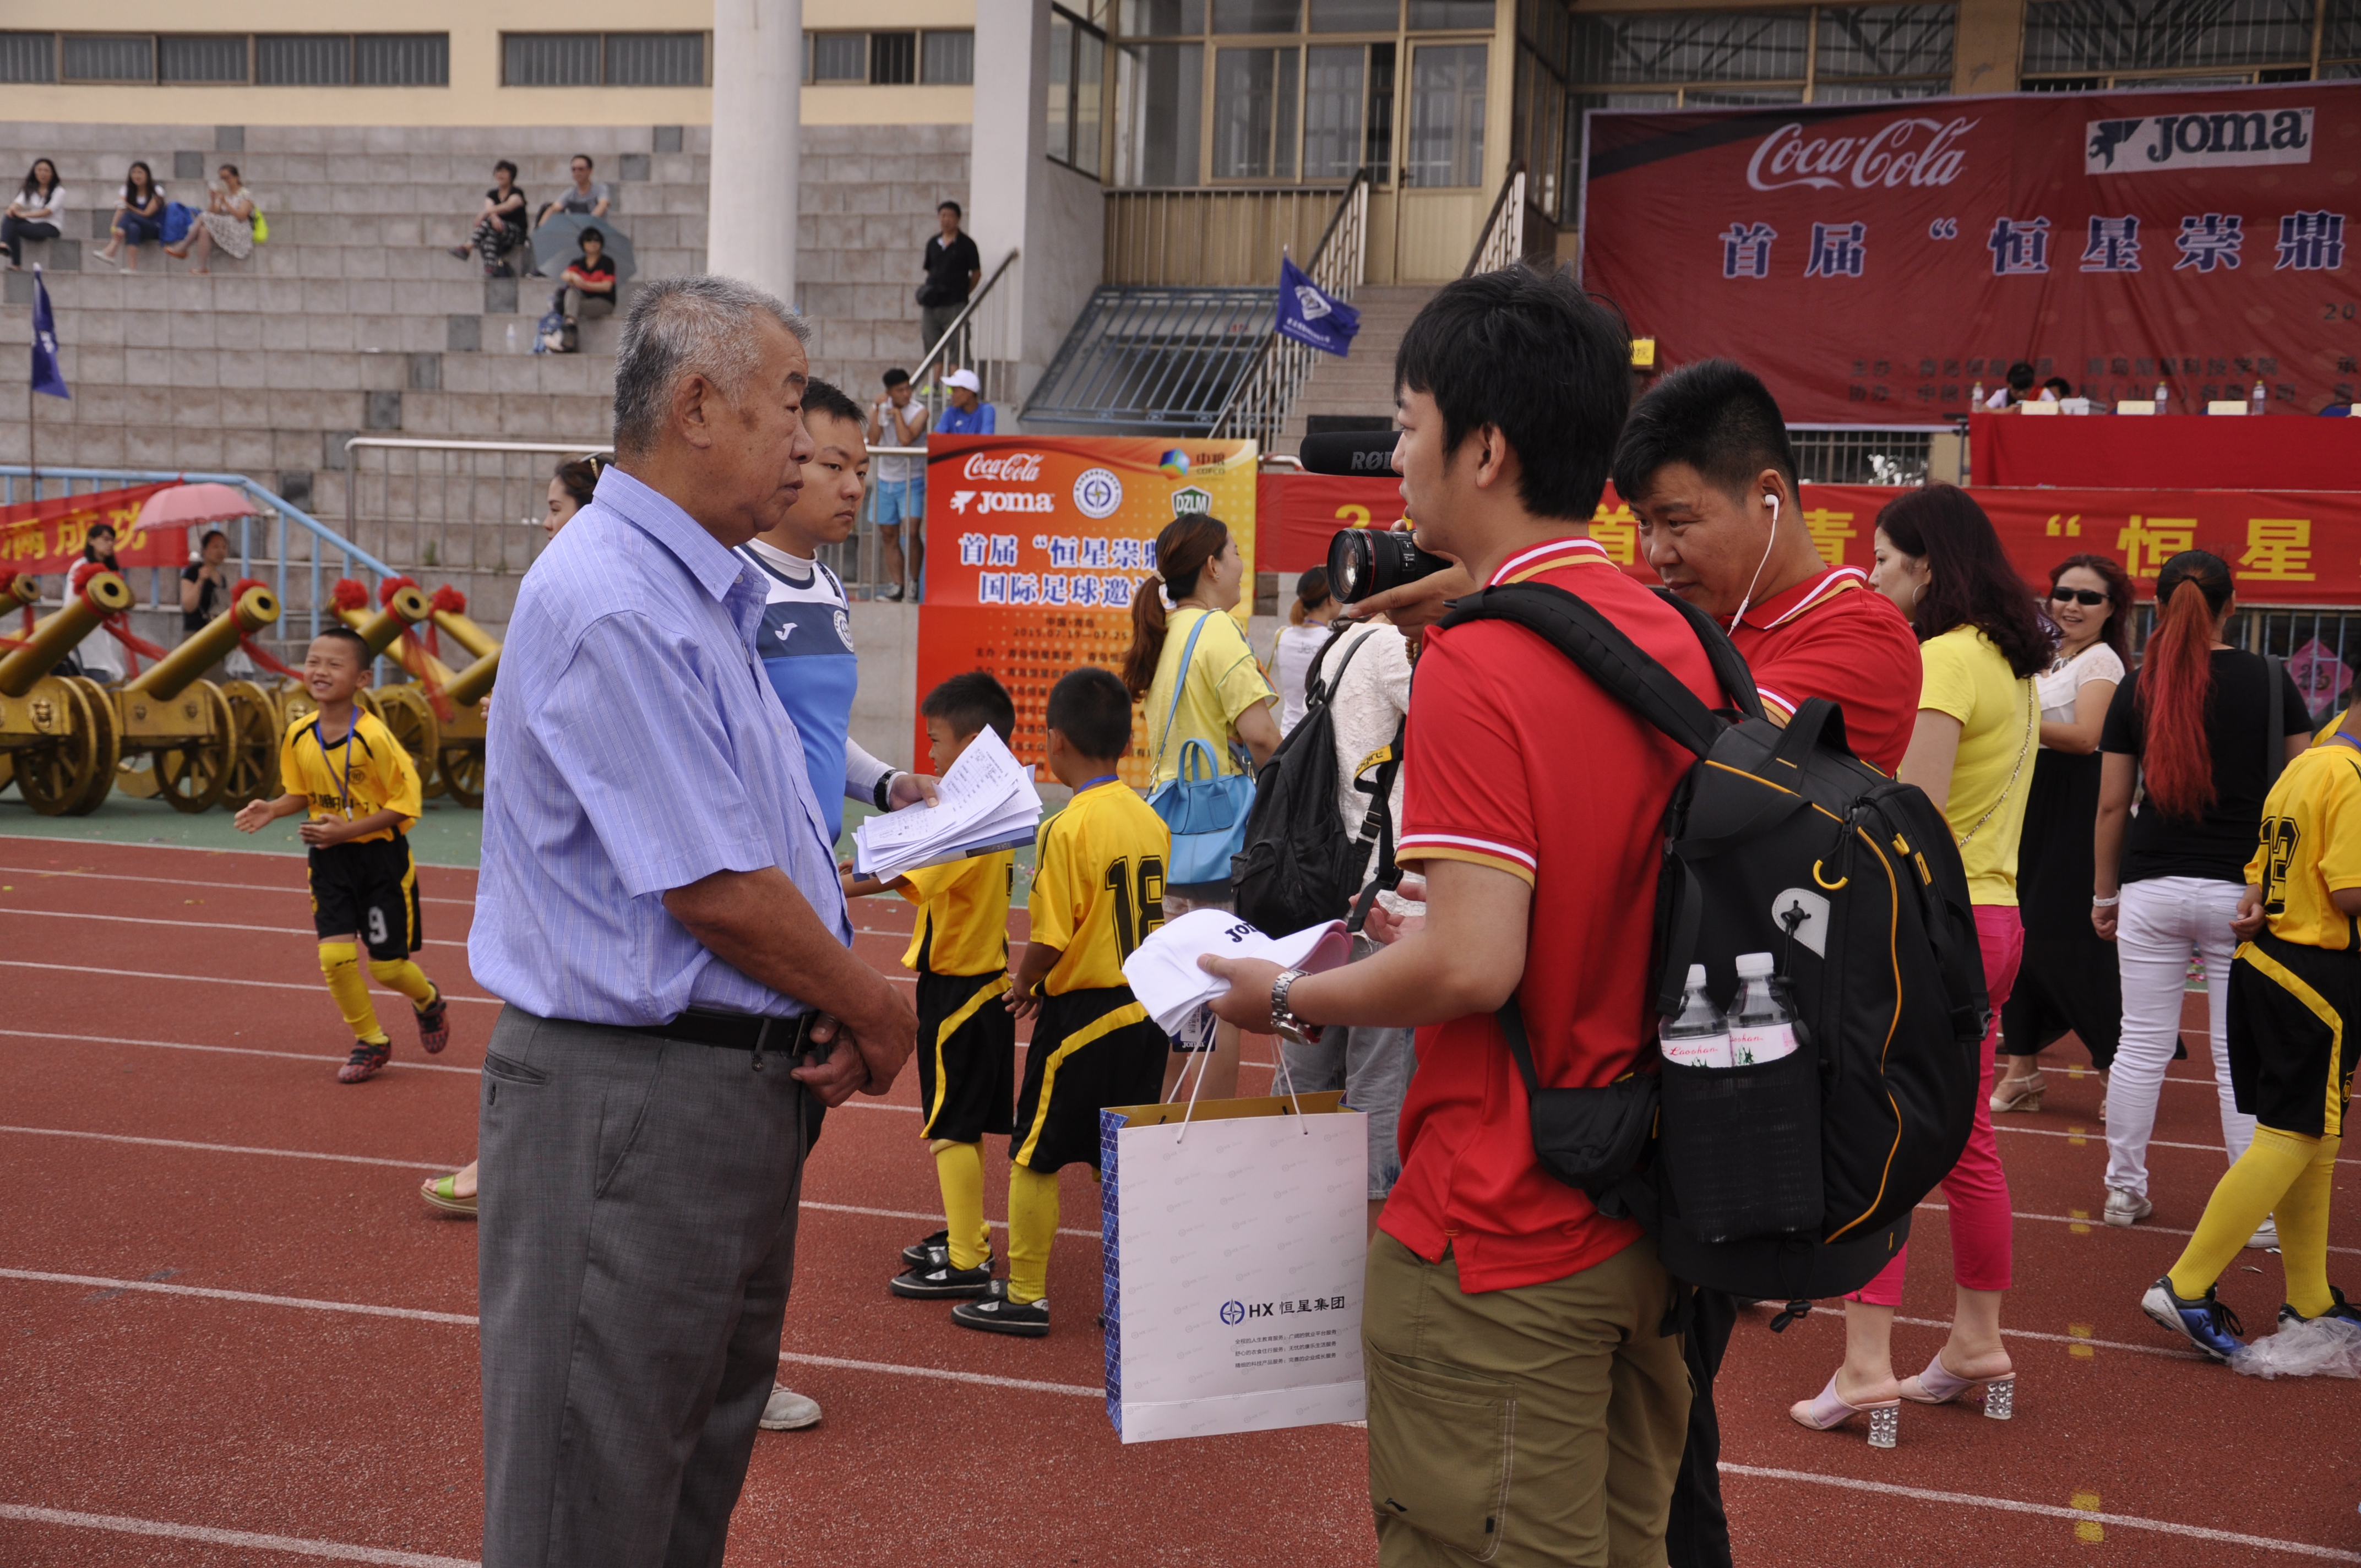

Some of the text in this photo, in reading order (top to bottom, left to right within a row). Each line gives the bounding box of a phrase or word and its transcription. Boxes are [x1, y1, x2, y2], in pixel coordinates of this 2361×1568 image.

[1747, 116, 1981, 191] Coca-Cola
[964, 452, 1045, 481] Coca-Cola
[1176, 494, 1207, 513] DZLM
[978, 570, 1145, 609] 国际足球邀
[368, 906, 388, 945] 9
[1105, 854, 1166, 971] 18
[1249, 1295, 1345, 1317] HX 恒星集团
